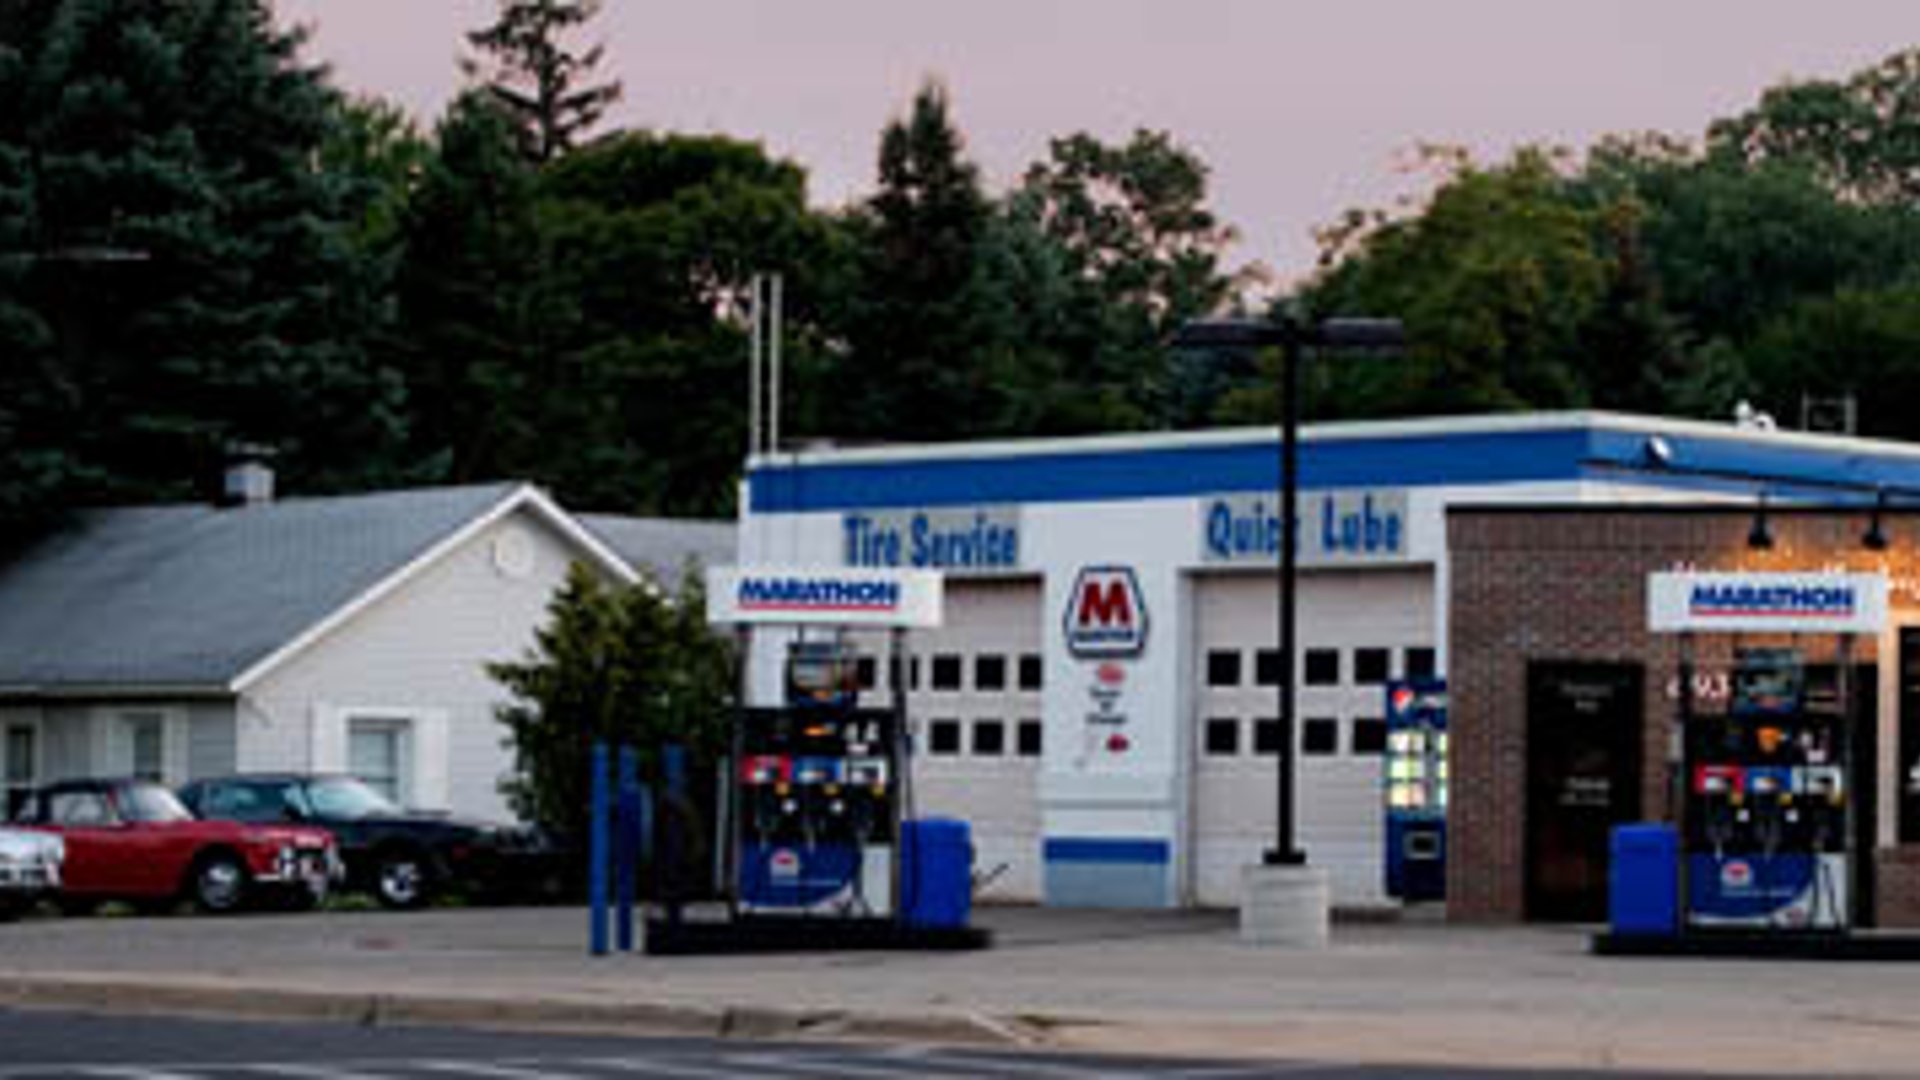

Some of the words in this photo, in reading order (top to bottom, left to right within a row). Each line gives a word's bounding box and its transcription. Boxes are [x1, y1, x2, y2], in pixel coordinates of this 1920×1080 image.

[844, 514, 899, 566] Tire
[911, 511, 1018, 566] Service
[1207, 499, 1300, 558] Quic
[1321, 494, 1401, 554] Lube
[738, 577, 899, 605] MARATHON
[1078, 579, 1131, 626] M
[1689, 582, 1855, 612] MARATHON
